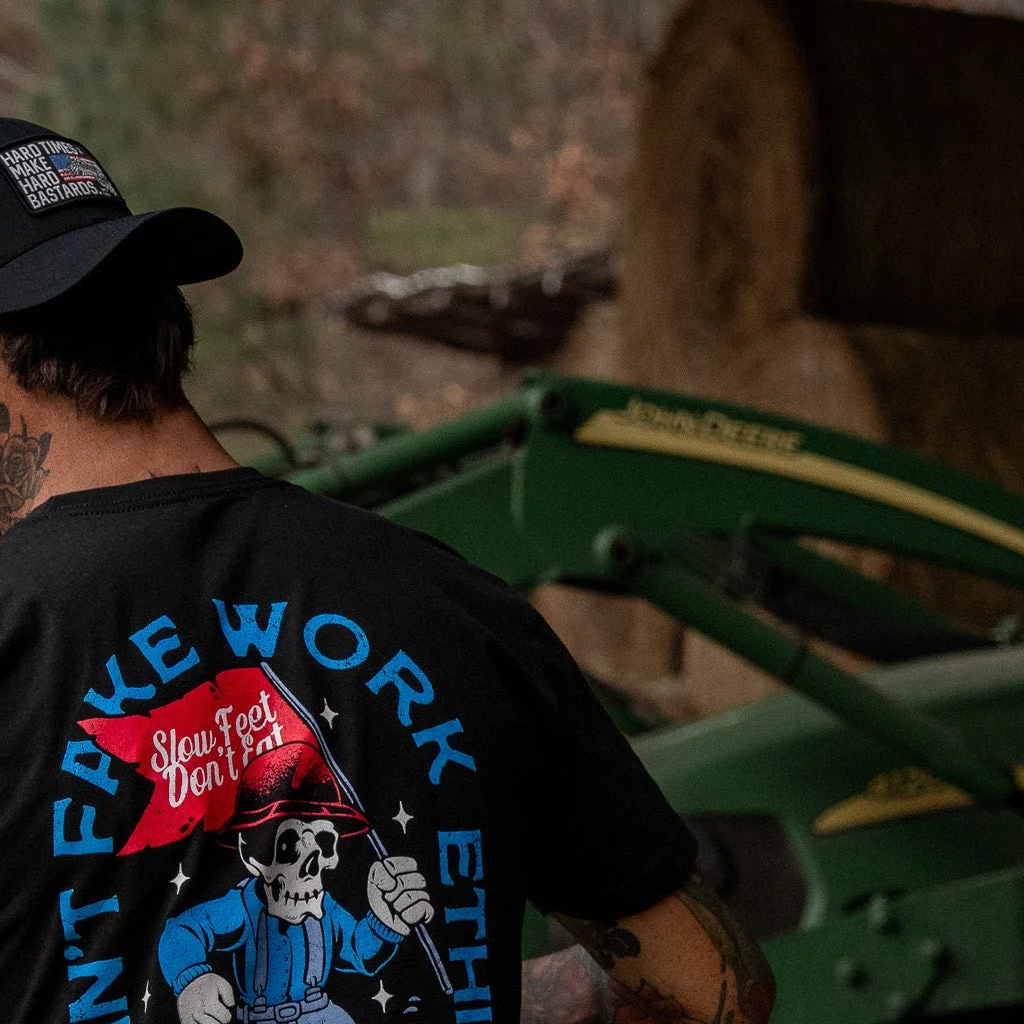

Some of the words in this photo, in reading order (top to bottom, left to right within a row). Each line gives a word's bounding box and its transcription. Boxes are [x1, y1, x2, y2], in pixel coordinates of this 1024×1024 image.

[0, 143, 43, 167] HARD
[9, 157, 53, 180] MAKE
[18, 170, 61, 195] HARD
[27, 181, 103, 210] BASTARDS.
[53, 614, 200, 857] FAKE
[212, 598, 477, 785] WORK
[151, 728, 217, 773] Slow
[215, 690, 277, 747] Feet
[162, 746, 239, 808] Don't
